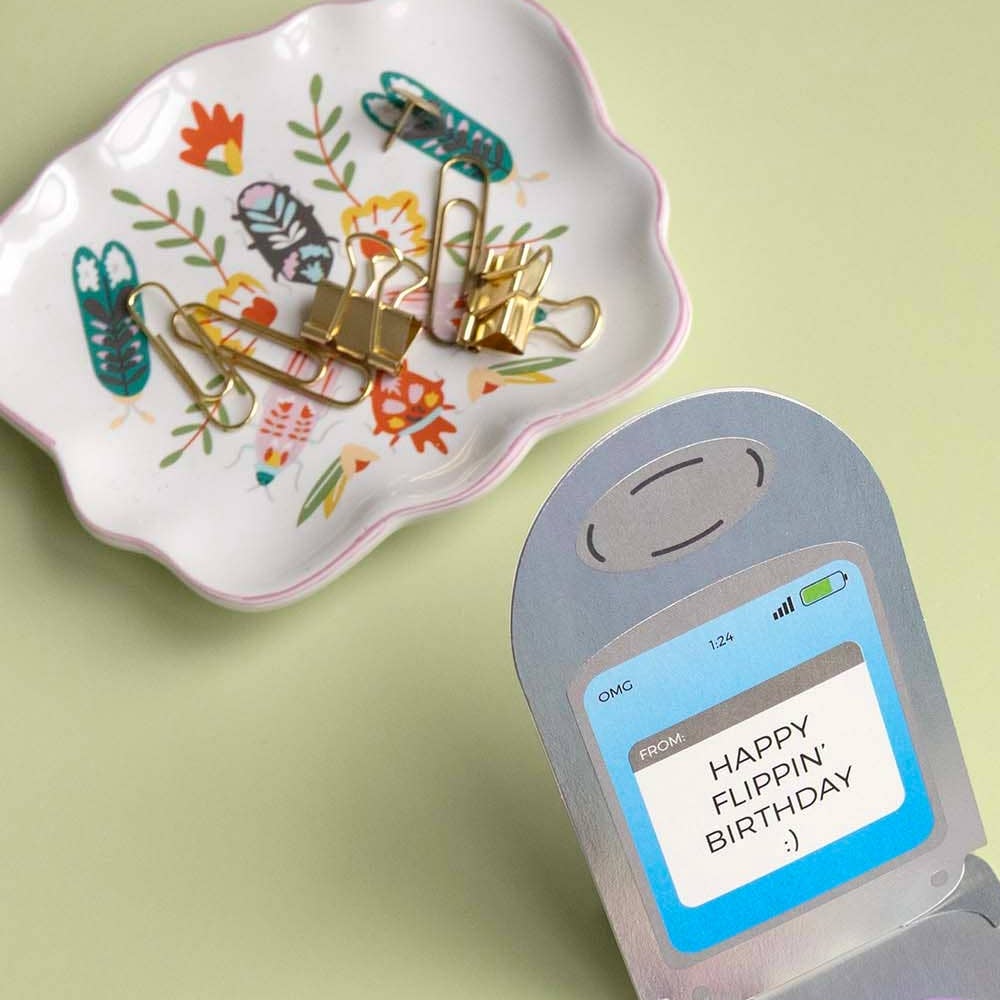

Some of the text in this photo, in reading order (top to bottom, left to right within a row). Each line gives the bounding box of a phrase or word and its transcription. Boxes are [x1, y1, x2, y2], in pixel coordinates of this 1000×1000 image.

[709, 632, 734, 650] 1:24
[598, 680, 633, 703] OMG
[639, 733, 686, 761] FROM:
[709, 715, 809, 781] HAPPY
[705, 766, 852, 854] BIRTHDAY
